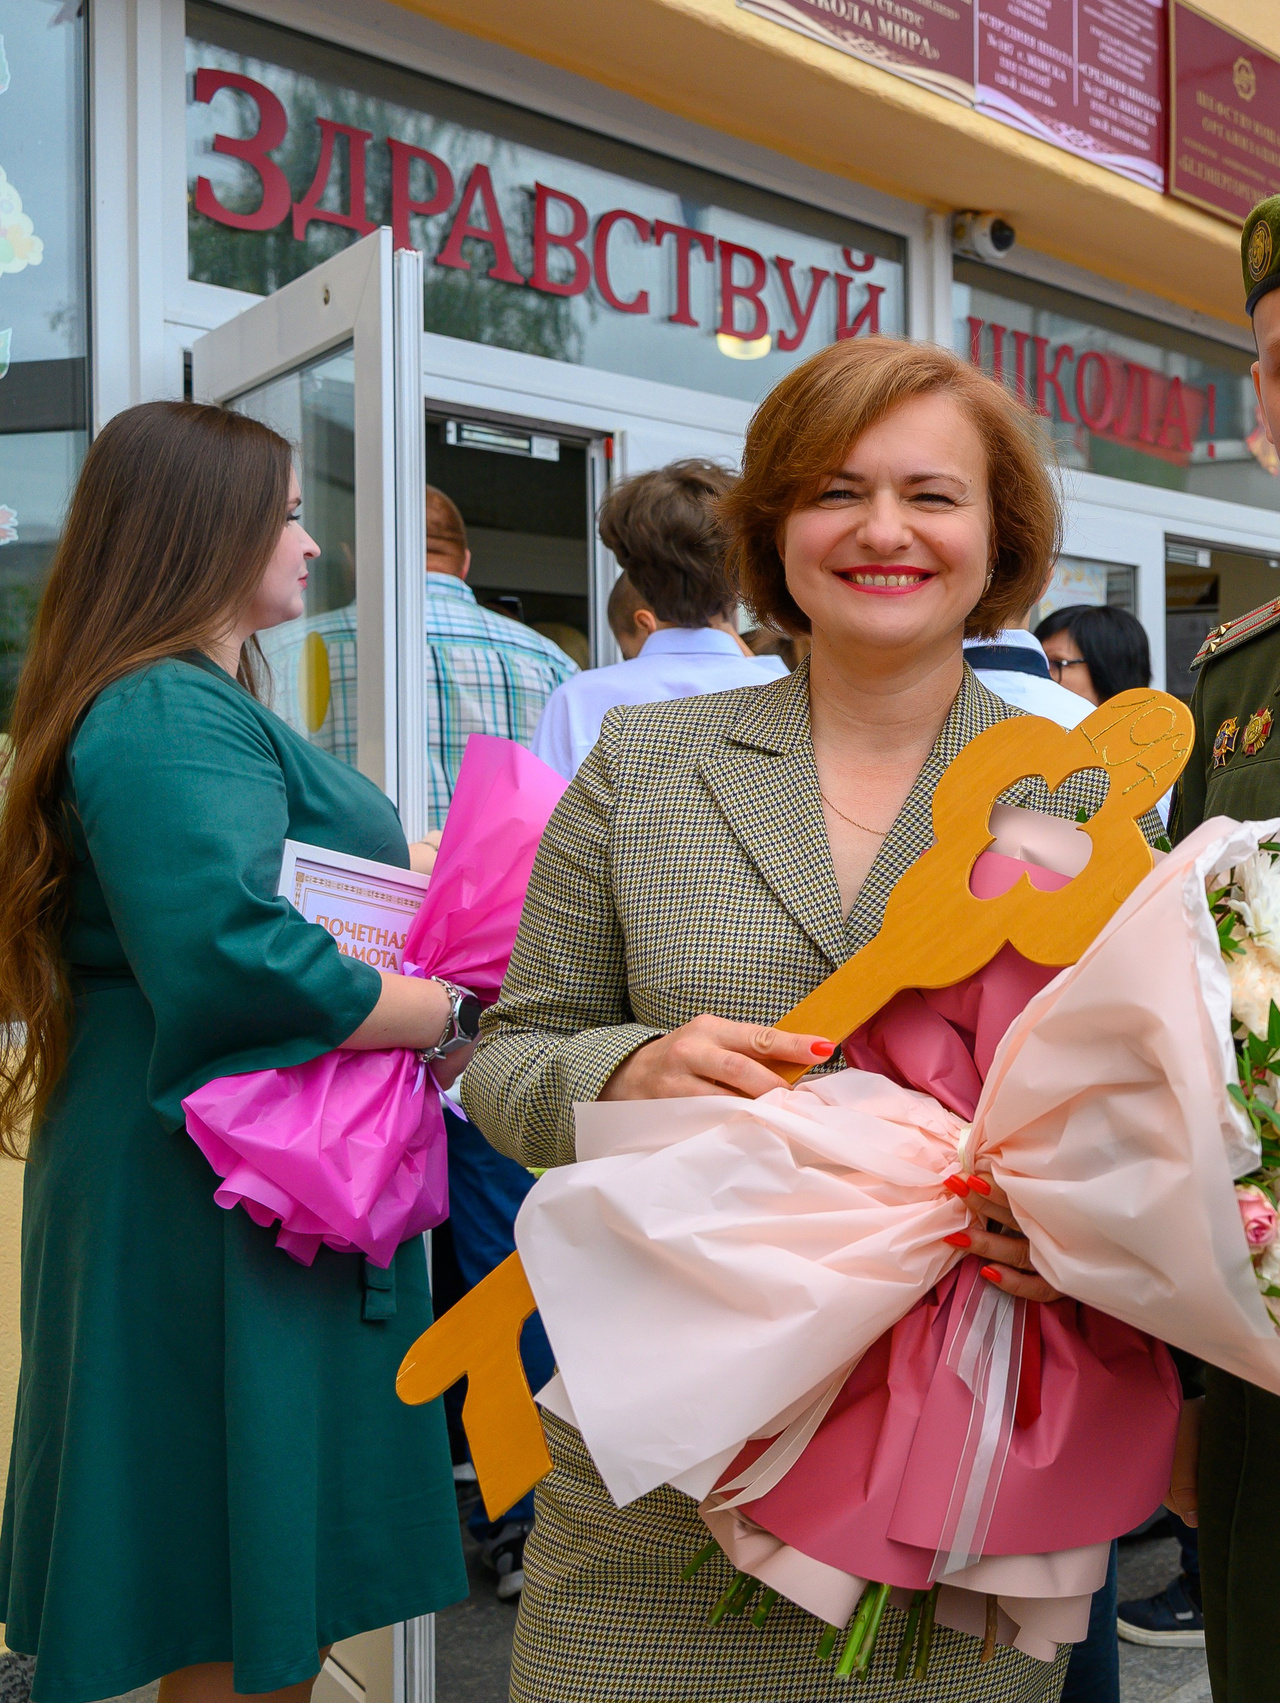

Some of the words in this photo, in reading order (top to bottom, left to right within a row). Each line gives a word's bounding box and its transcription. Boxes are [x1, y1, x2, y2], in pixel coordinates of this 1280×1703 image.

[803, 0, 874, 32] КОЛА
[877, 15, 940, 60] МИРА»
[194, 67, 886, 352] ЗДРАВСТВУЙ
[315, 914, 408, 949] ПОЧЕТНАЯ
[337, 940, 399, 970] АМОТА
